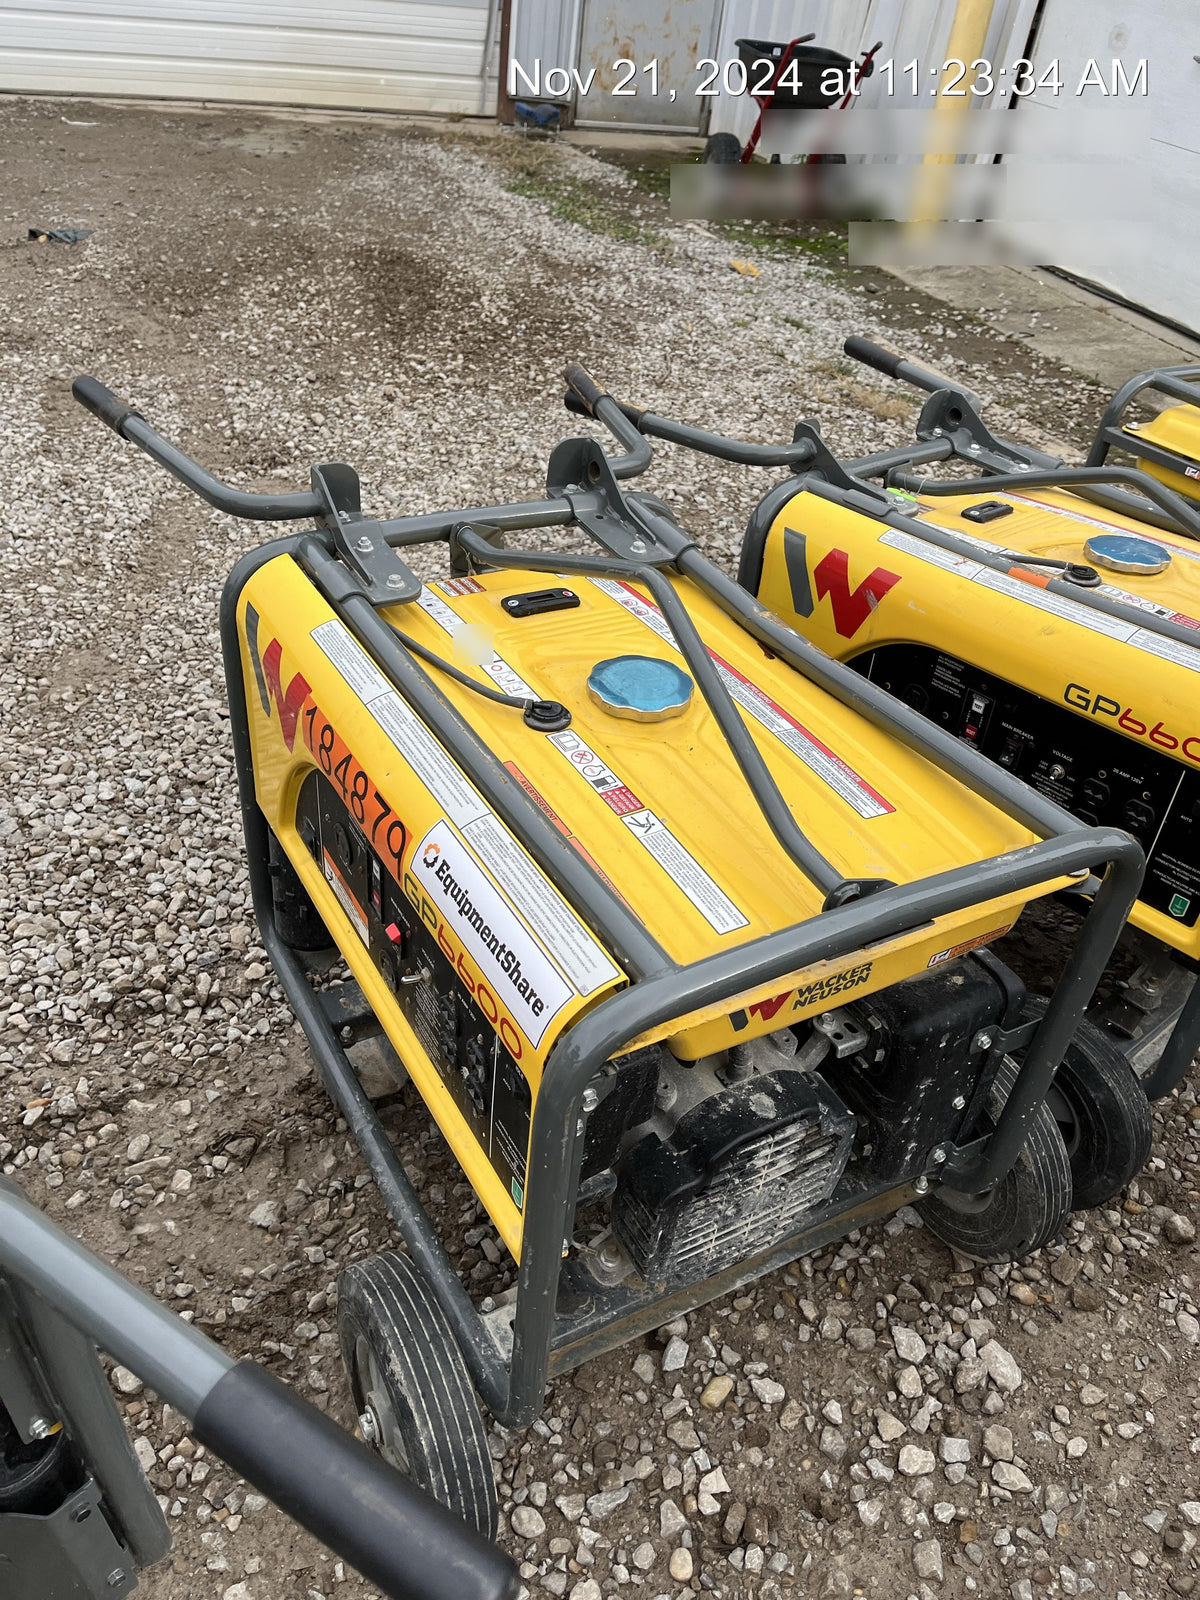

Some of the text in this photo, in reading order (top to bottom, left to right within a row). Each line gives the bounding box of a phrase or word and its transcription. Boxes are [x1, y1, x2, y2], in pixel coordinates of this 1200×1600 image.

[305, 705, 406, 882] 184879
[520, 780, 559, 822] AVERTISSEMENT
[403, 872, 522, 1060] GP6600
[796, 961, 873, 999] WACKER
[792, 971, 871, 1010] NEUSON
